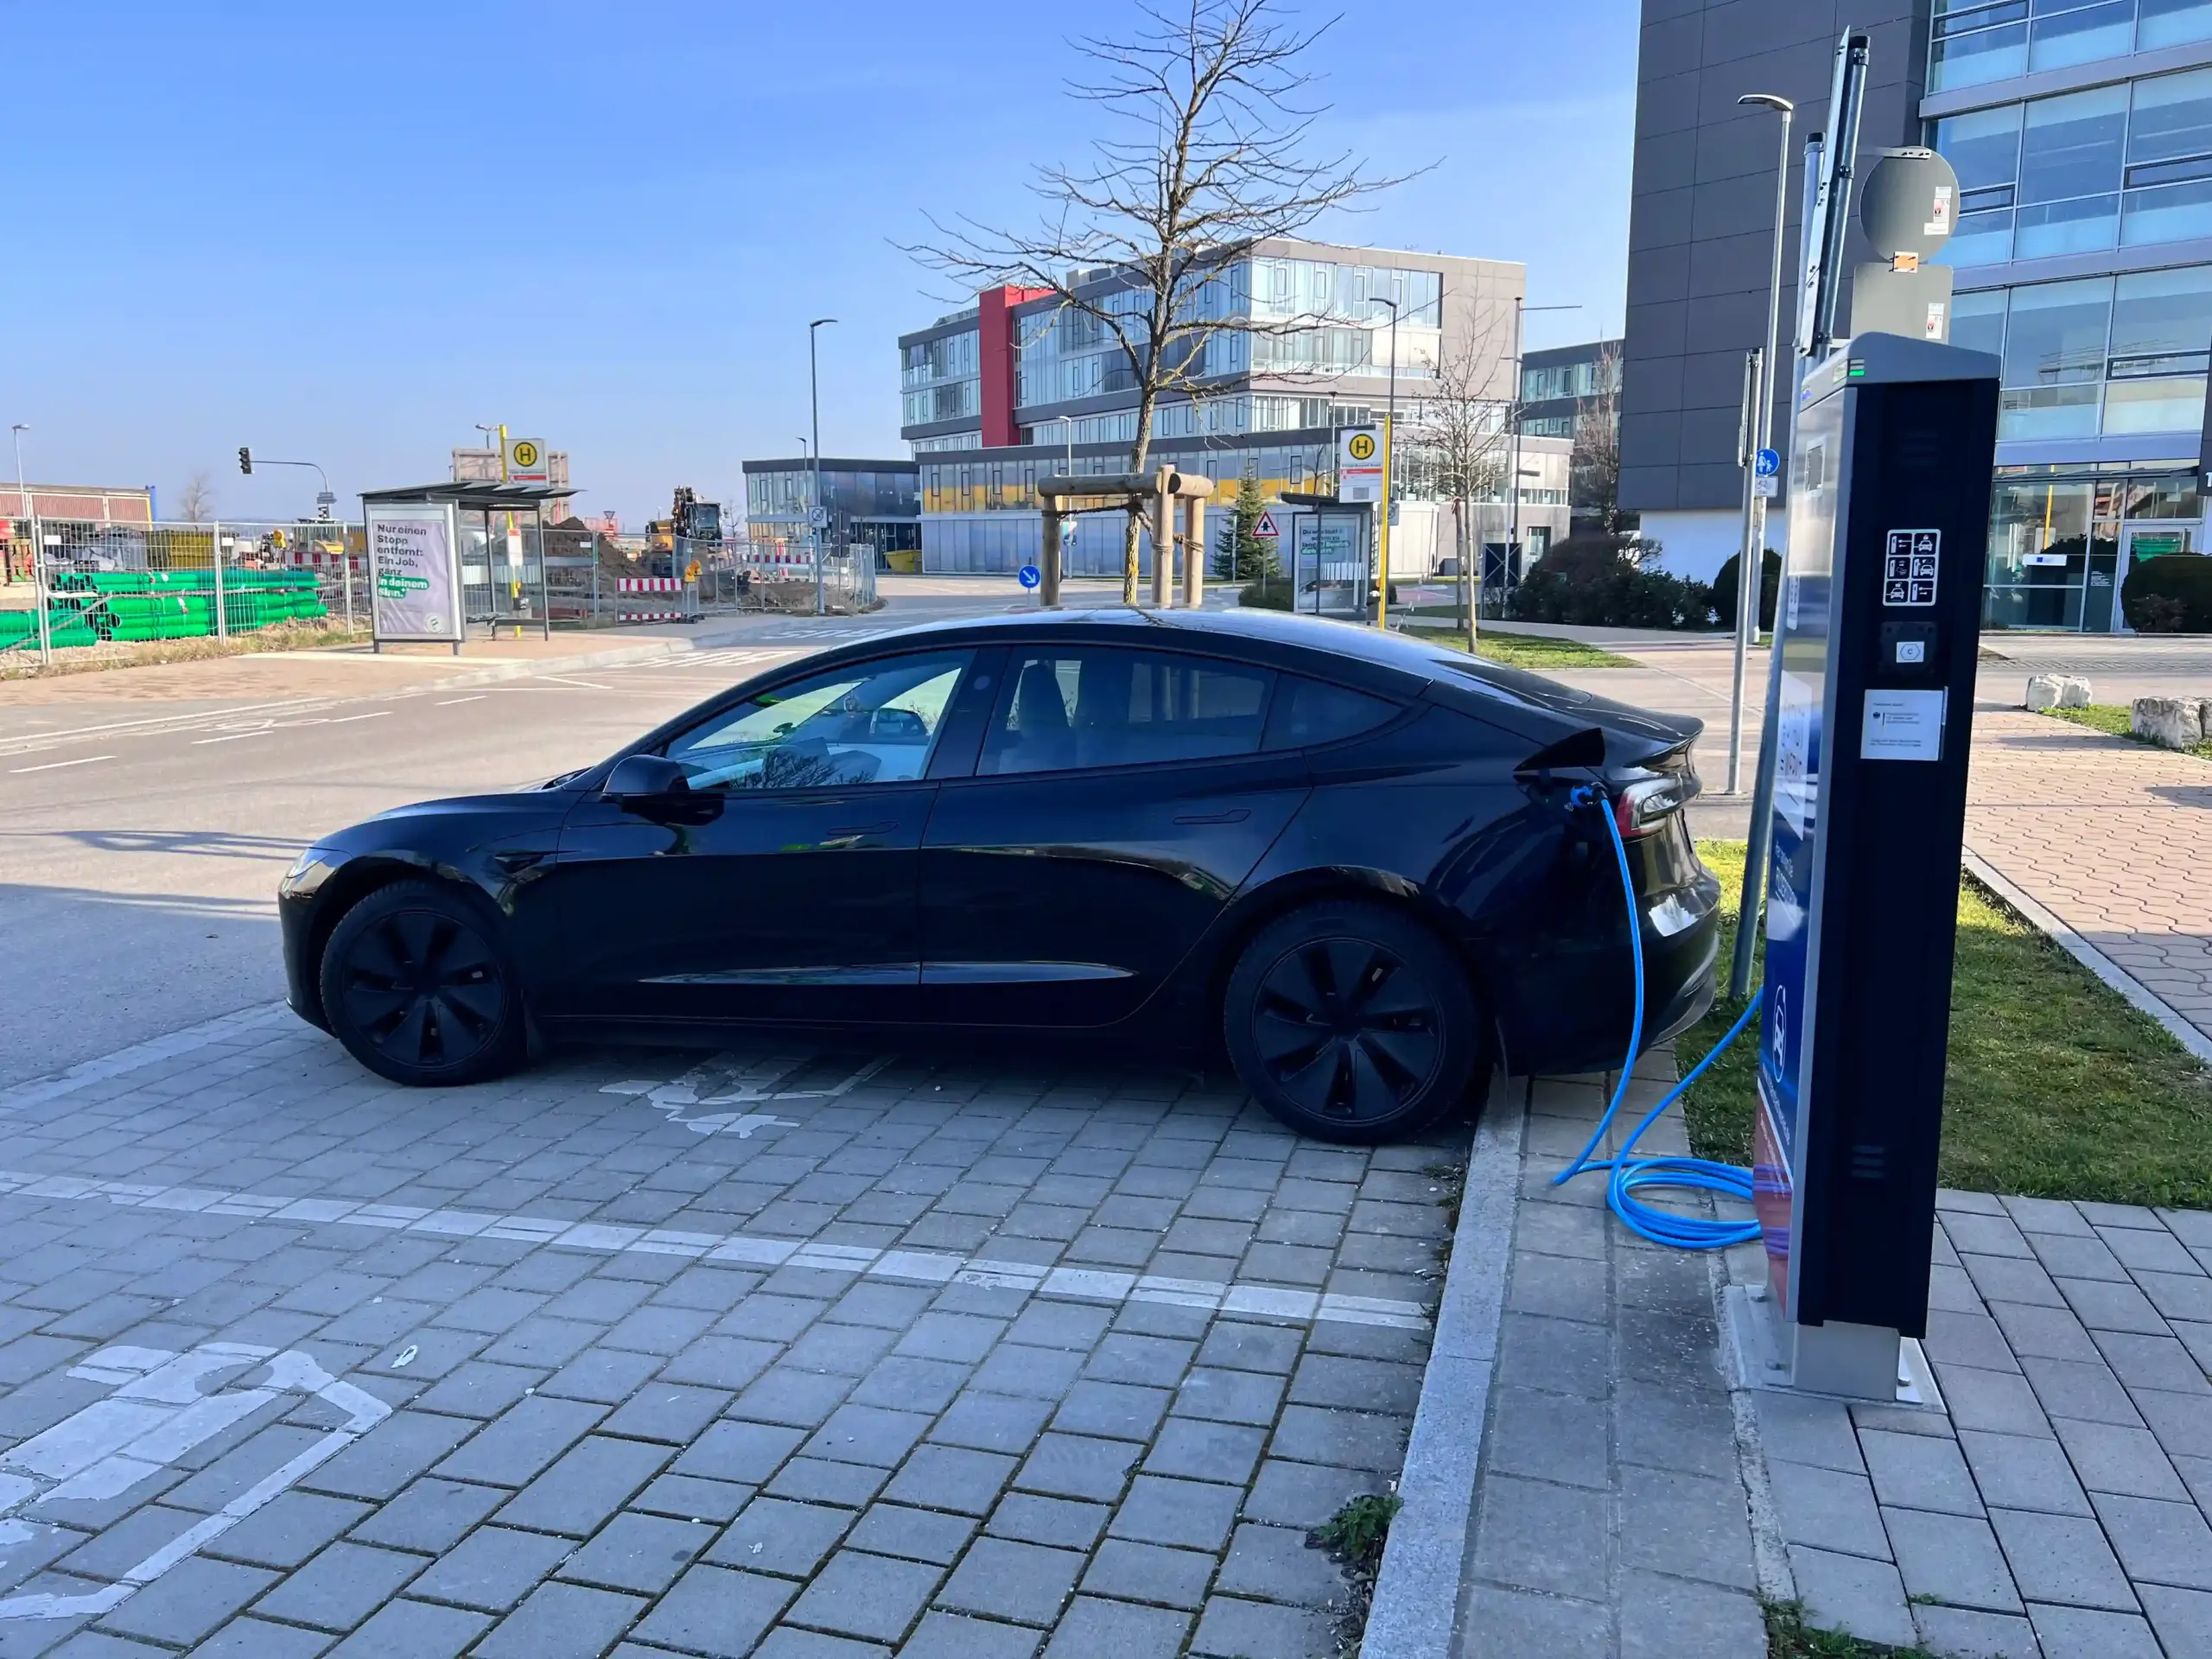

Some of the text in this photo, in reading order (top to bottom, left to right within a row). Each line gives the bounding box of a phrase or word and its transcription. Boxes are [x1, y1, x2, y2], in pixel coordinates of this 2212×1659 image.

[1356, 440, 1368, 454] H
[519, 448, 531, 461] H
[377, 524, 427, 536] Nur einen
[377, 535, 408, 545] Stopp
[377, 546, 423, 556] entfernt:
[378, 556, 418, 568] Ein Job,
[378, 568, 403, 577] ganz
[389, 577, 428, 588] deinem
[604, 651, 800, 668] BUS
